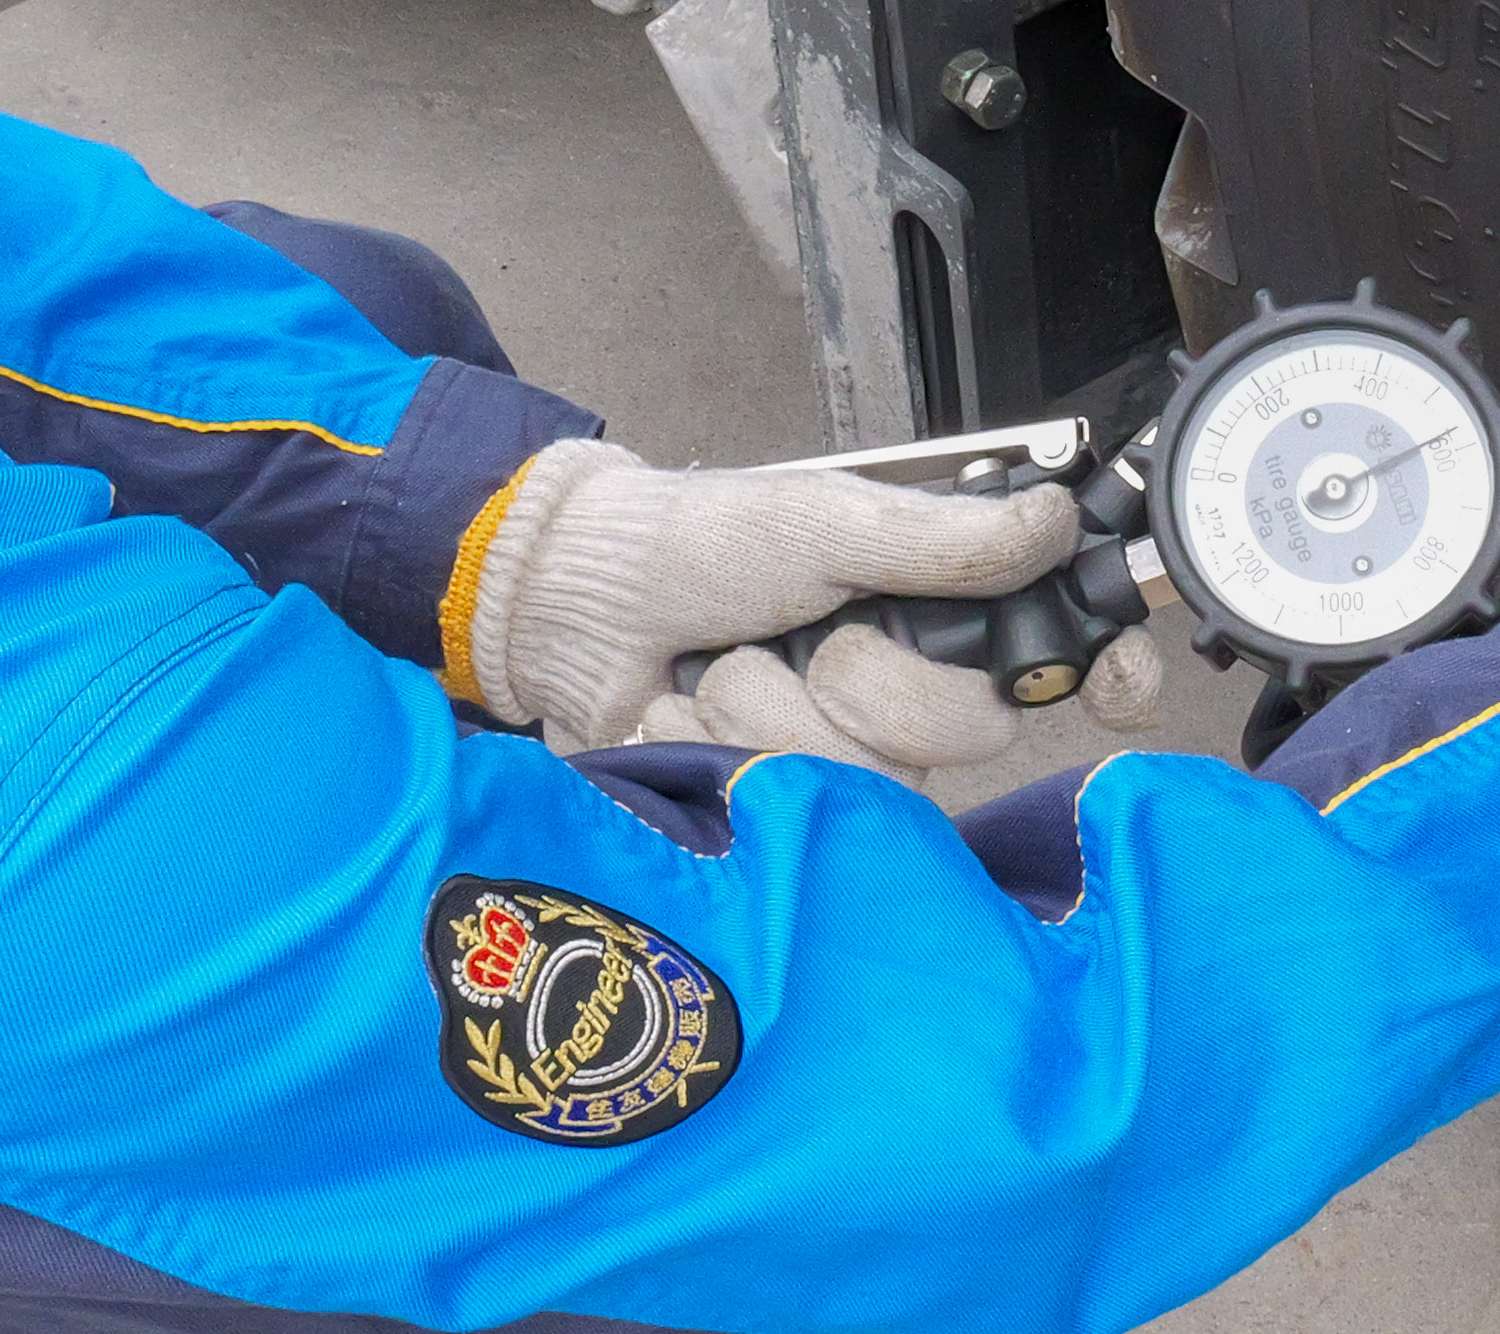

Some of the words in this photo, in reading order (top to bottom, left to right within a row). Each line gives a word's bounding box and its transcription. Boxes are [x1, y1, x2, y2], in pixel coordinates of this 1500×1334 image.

[1255, 388, 1290, 422] 200
[1353, 375, 1388, 400] 400
[1428, 433, 1456, 473] 600
[1217, 472, 1238, 485] 0
[1263, 454, 1287, 492] tire
[1250, 496, 1274, 539] kPa
[1274, 496, 1312, 564] gauge
[1231, 541, 1270, 584] 1200
[1413, 535, 1445, 572] 800
[1318, 590, 1364, 613] 1000
[530, 934, 634, 1093] Engineer
